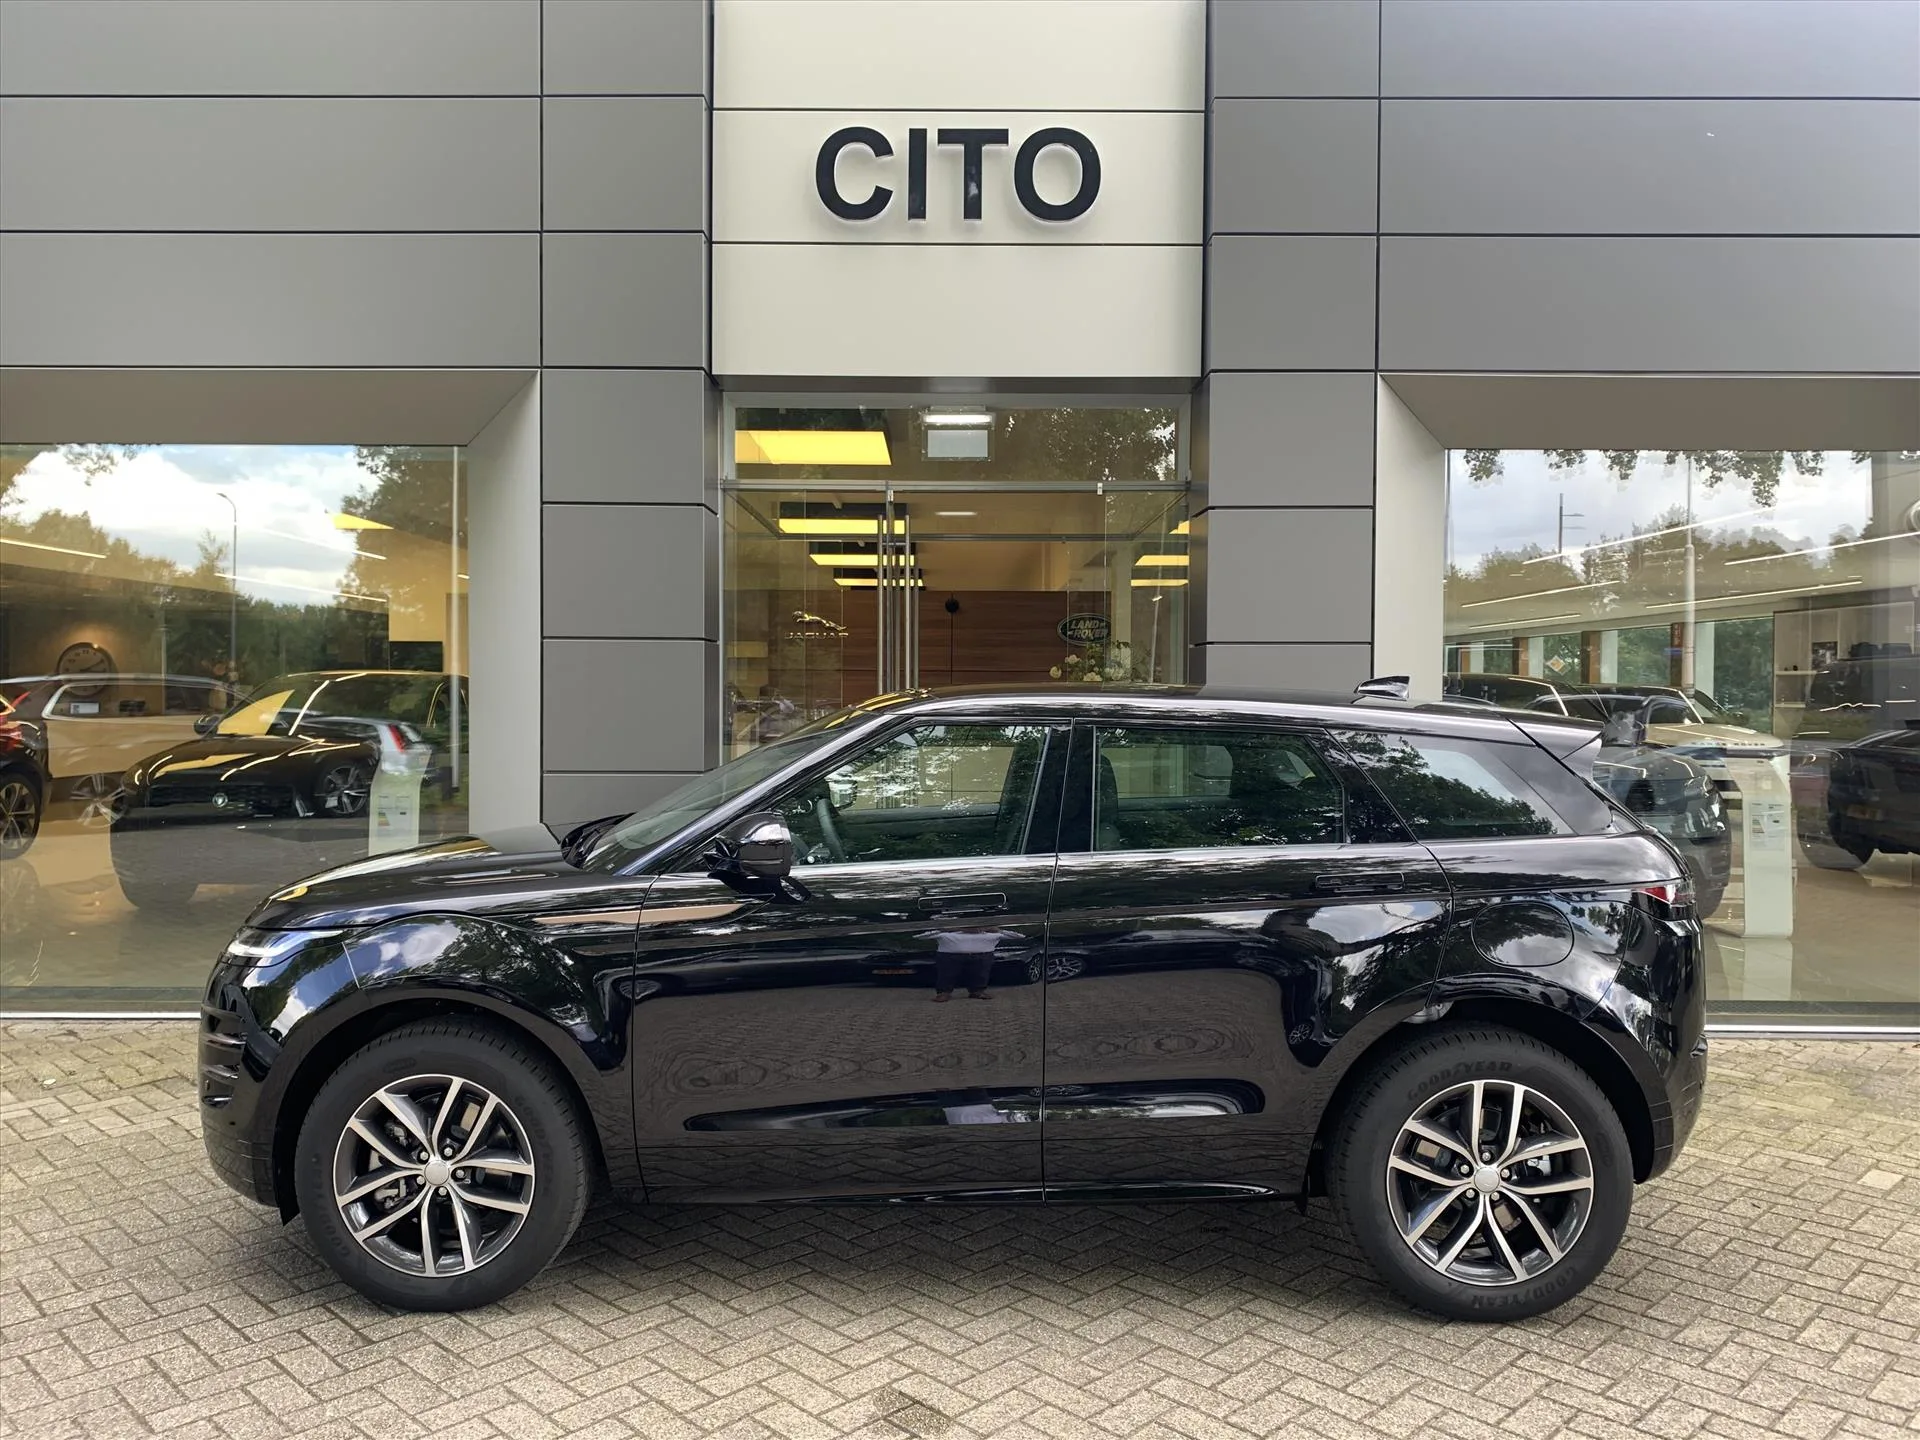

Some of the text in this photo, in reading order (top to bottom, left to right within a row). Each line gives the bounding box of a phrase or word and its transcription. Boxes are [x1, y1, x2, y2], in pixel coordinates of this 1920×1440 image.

[815, 126, 1101, 222] CITO
[1071, 619, 1099, 629] LAND
[1408, 1060, 1513, 1101] GOODYEAR
